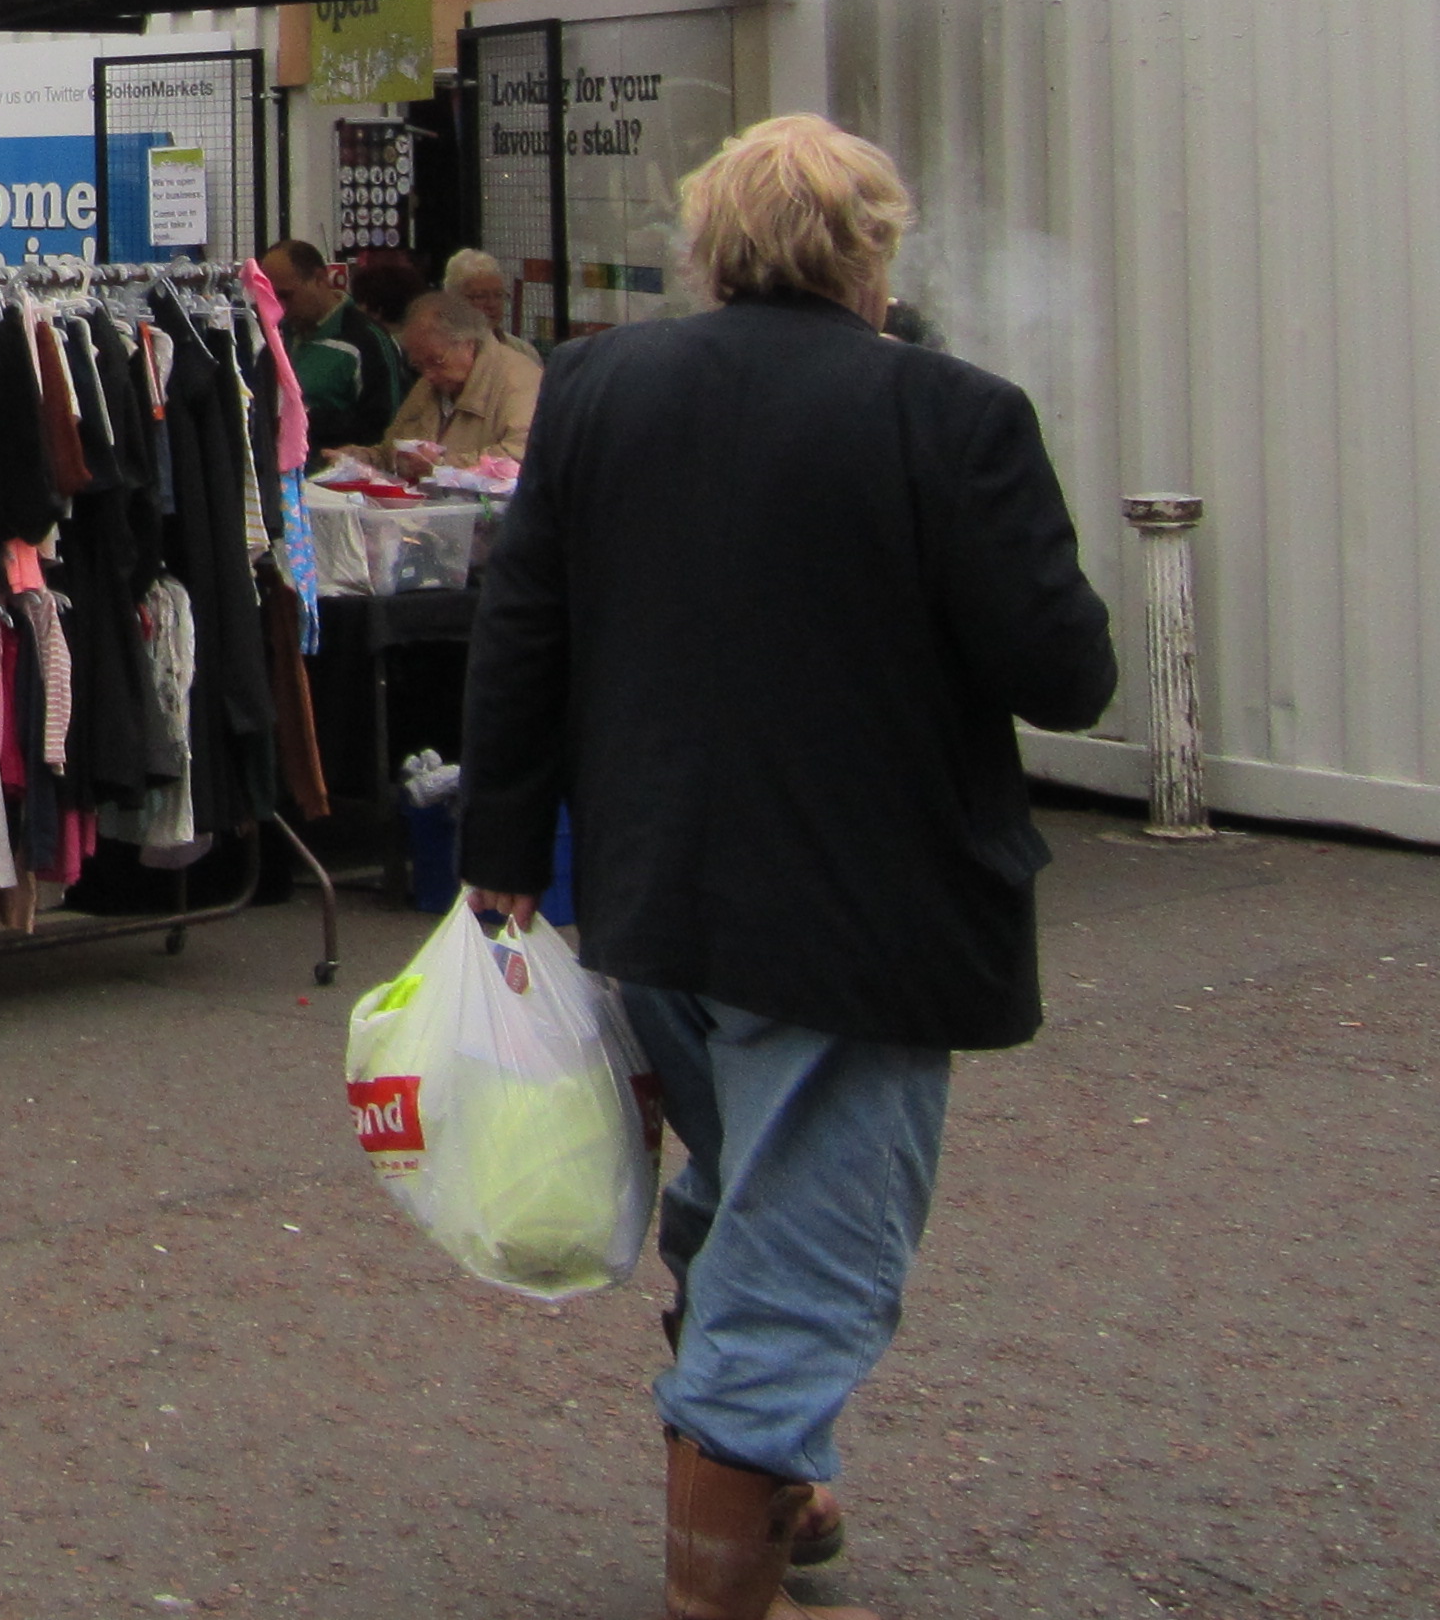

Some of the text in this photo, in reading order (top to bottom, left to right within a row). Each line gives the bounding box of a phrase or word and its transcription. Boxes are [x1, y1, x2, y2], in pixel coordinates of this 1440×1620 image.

[6, 90, 21, 105] us
[25, 90, 41, 104] on
[44, 85, 85, 103] Twitter
[576, 66, 605, 103] for
[607, 74, 662, 112] your
[583, 118, 643, 156] stall?
